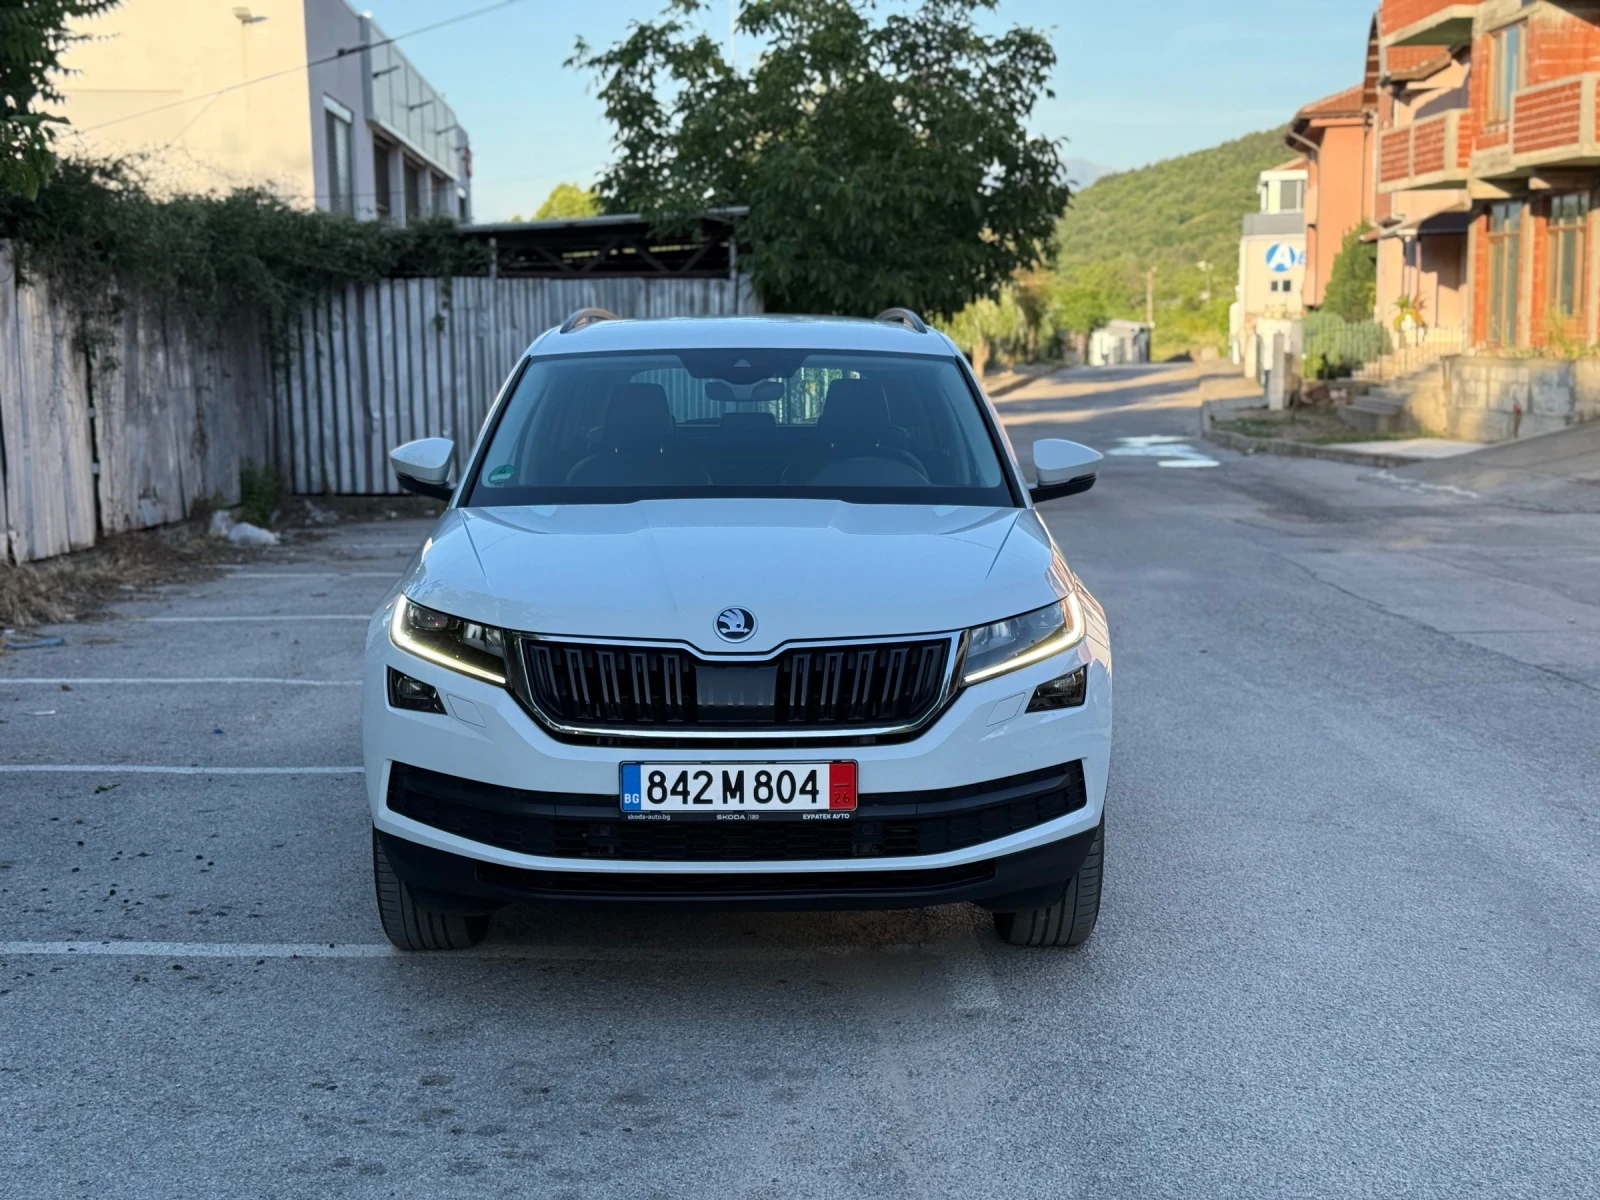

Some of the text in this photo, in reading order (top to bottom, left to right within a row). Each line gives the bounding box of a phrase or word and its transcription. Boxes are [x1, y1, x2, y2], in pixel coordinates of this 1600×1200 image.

[647, 770, 819, 804] 842 M 804
[624, 793, 640, 804] BG
[833, 792, 850, 804] 26
[627, 813, 671, 821] skoda-auto.bg
